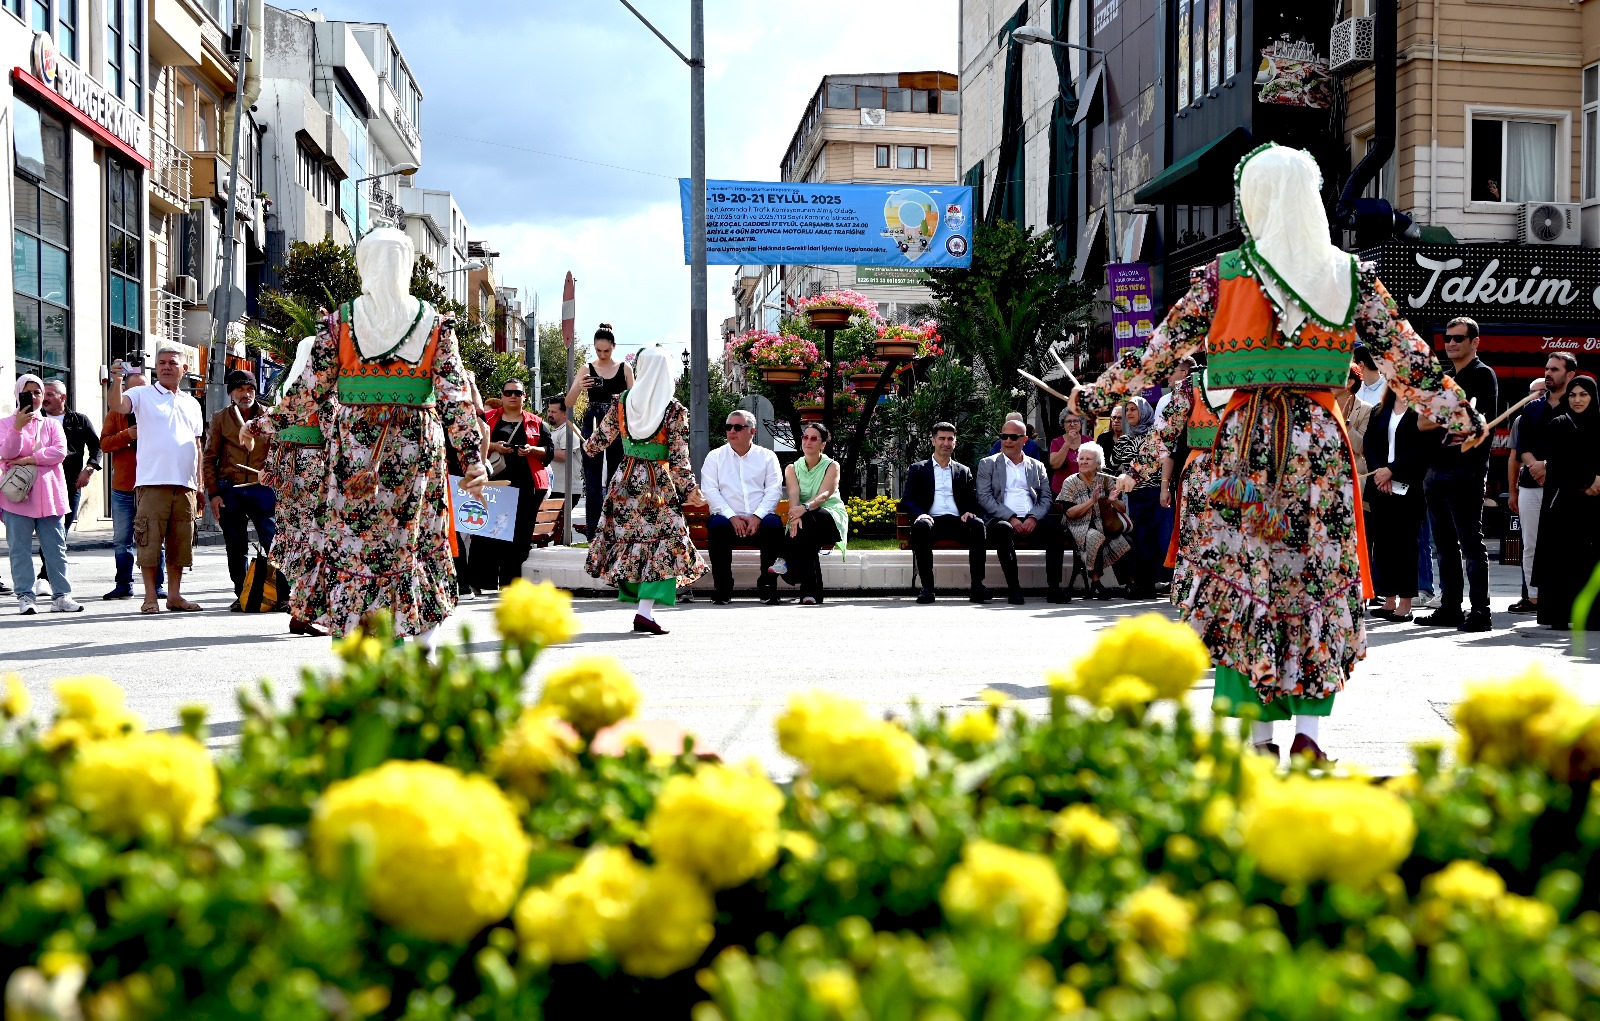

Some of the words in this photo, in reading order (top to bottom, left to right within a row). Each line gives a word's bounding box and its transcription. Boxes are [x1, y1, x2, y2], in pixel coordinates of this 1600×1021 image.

[63, 67, 114, 133] BURGER
[114, 102, 142, 151] KING
[706, 193, 765, 203] -19-20-21
[767, 191, 809, 204] EYLÜL
[811, 194, 842, 205] 2025
[1407, 252, 1580, 309] Taksim
[1540, 336, 1581, 350] Taksim
